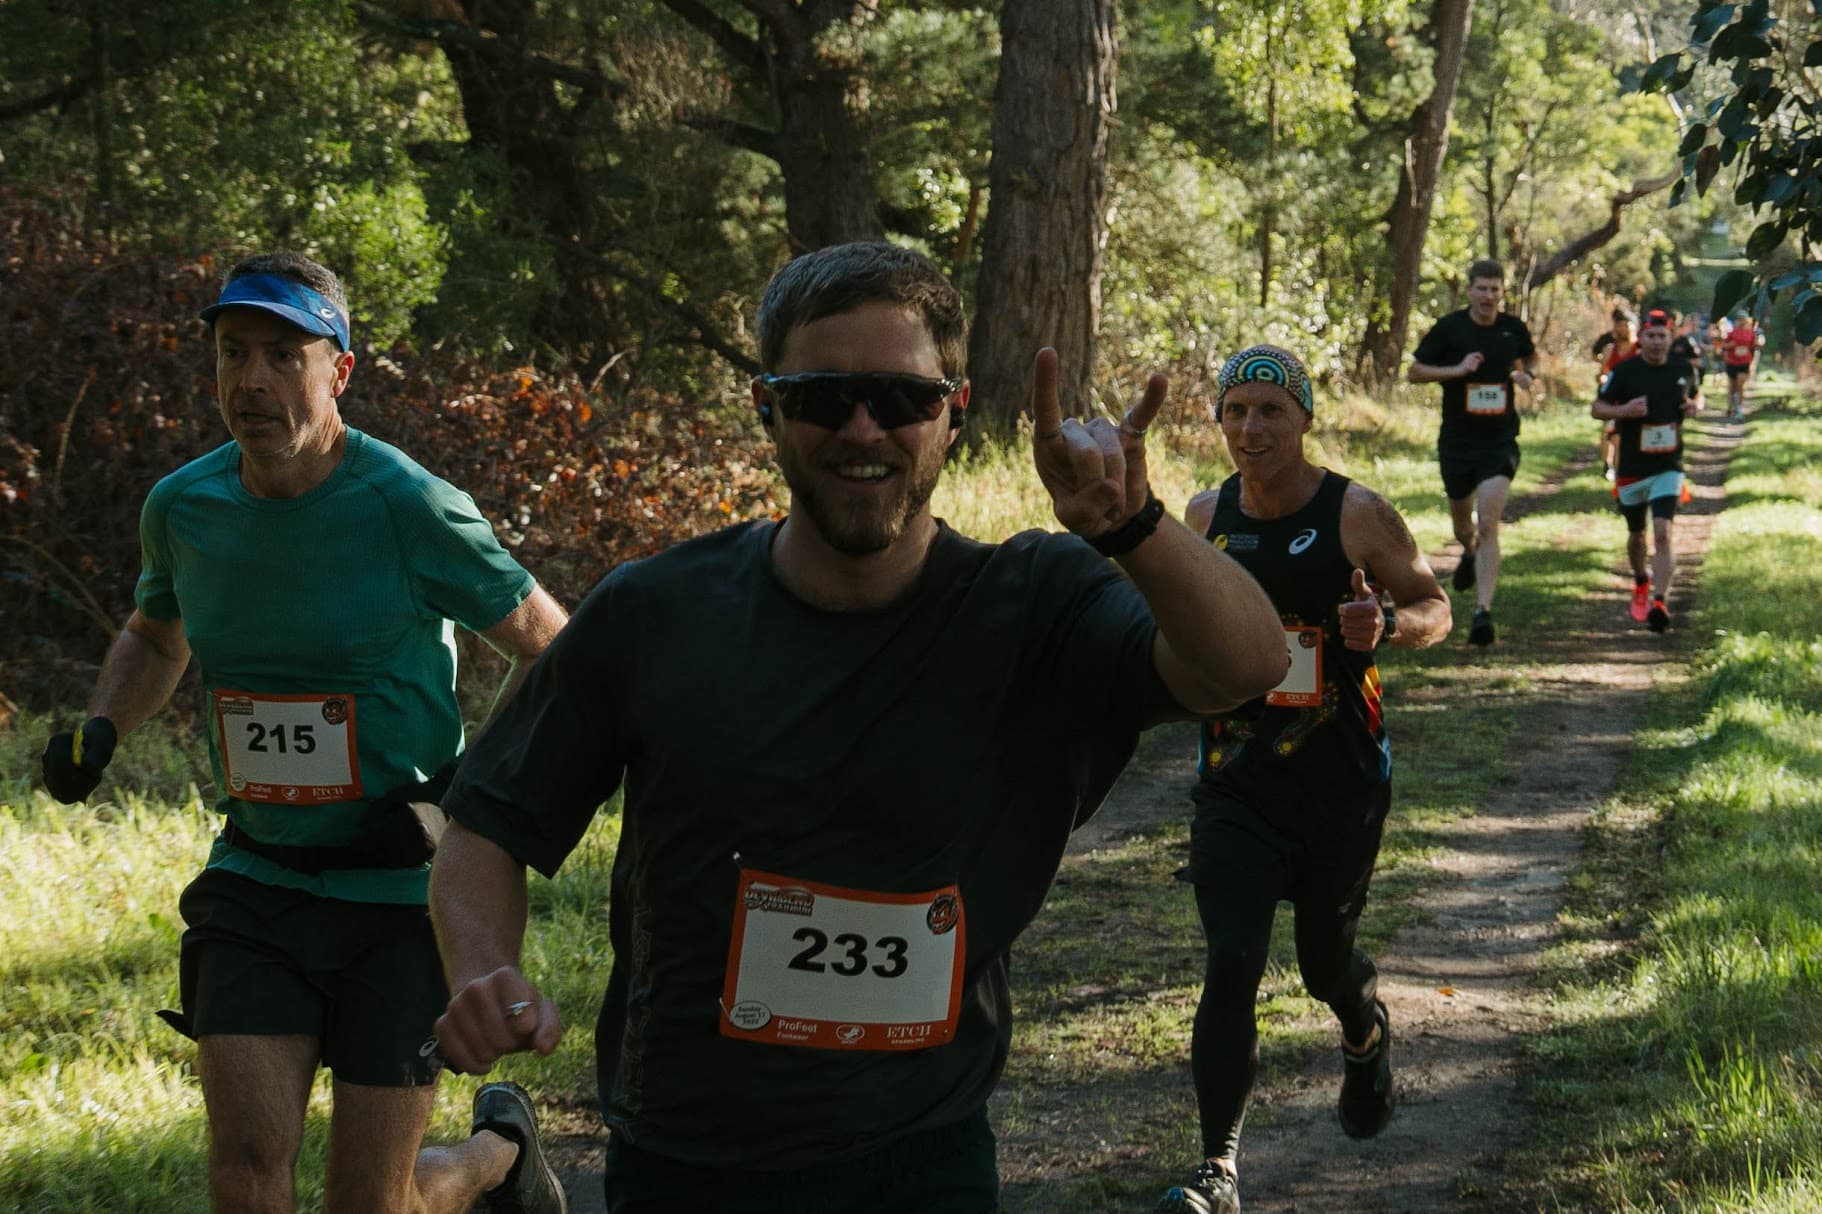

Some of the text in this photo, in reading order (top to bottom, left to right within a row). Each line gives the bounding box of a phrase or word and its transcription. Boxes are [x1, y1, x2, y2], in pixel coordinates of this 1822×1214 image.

[246, 722, 316, 754] 215
[788, 927, 909, 978] 233
[887, 1024, 931, 1038] ETCH
